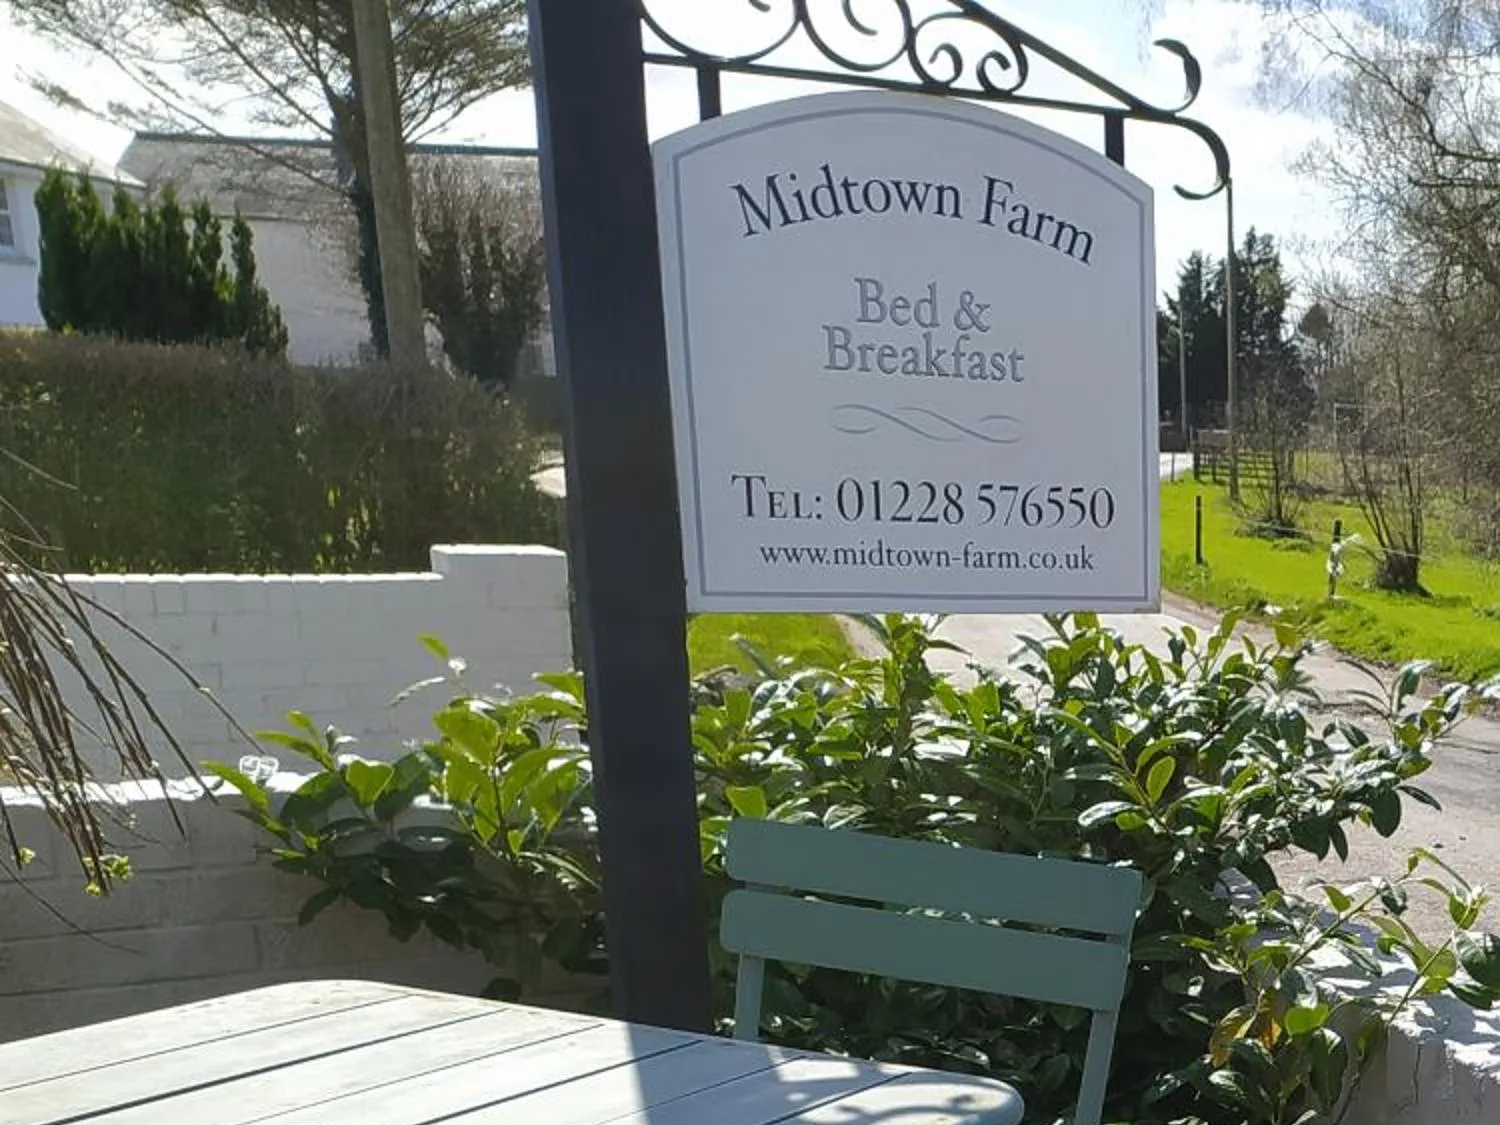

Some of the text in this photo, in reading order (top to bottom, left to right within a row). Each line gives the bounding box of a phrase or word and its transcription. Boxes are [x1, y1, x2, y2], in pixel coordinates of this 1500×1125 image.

[730, 163, 1096, 267] Midtown Farm
[853, 277, 992, 332] Bed &
[821, 325, 1025, 383] Breakfast
[835, 477, 965, 525] 01228
[977, 485, 1116, 529] 576550
[760, 539, 1095, 571] www.midtown-farm.co.uk
